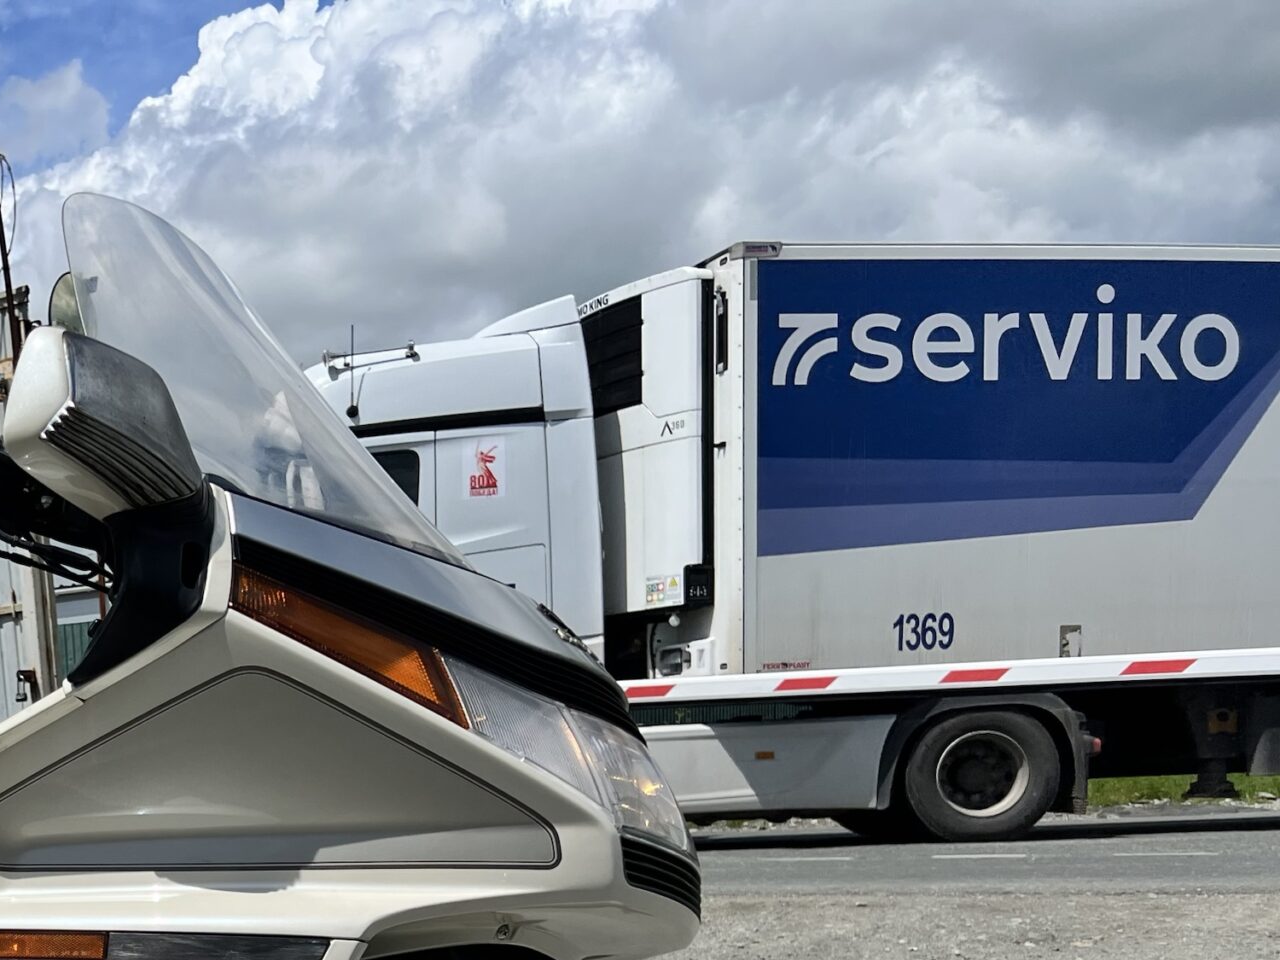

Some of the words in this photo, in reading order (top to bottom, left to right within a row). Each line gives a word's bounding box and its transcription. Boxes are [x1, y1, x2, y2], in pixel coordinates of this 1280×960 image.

[589, 294, 609, 312] KING
[470, 474, 484, 489] 80
[893, 612, 954, 651] 1369
